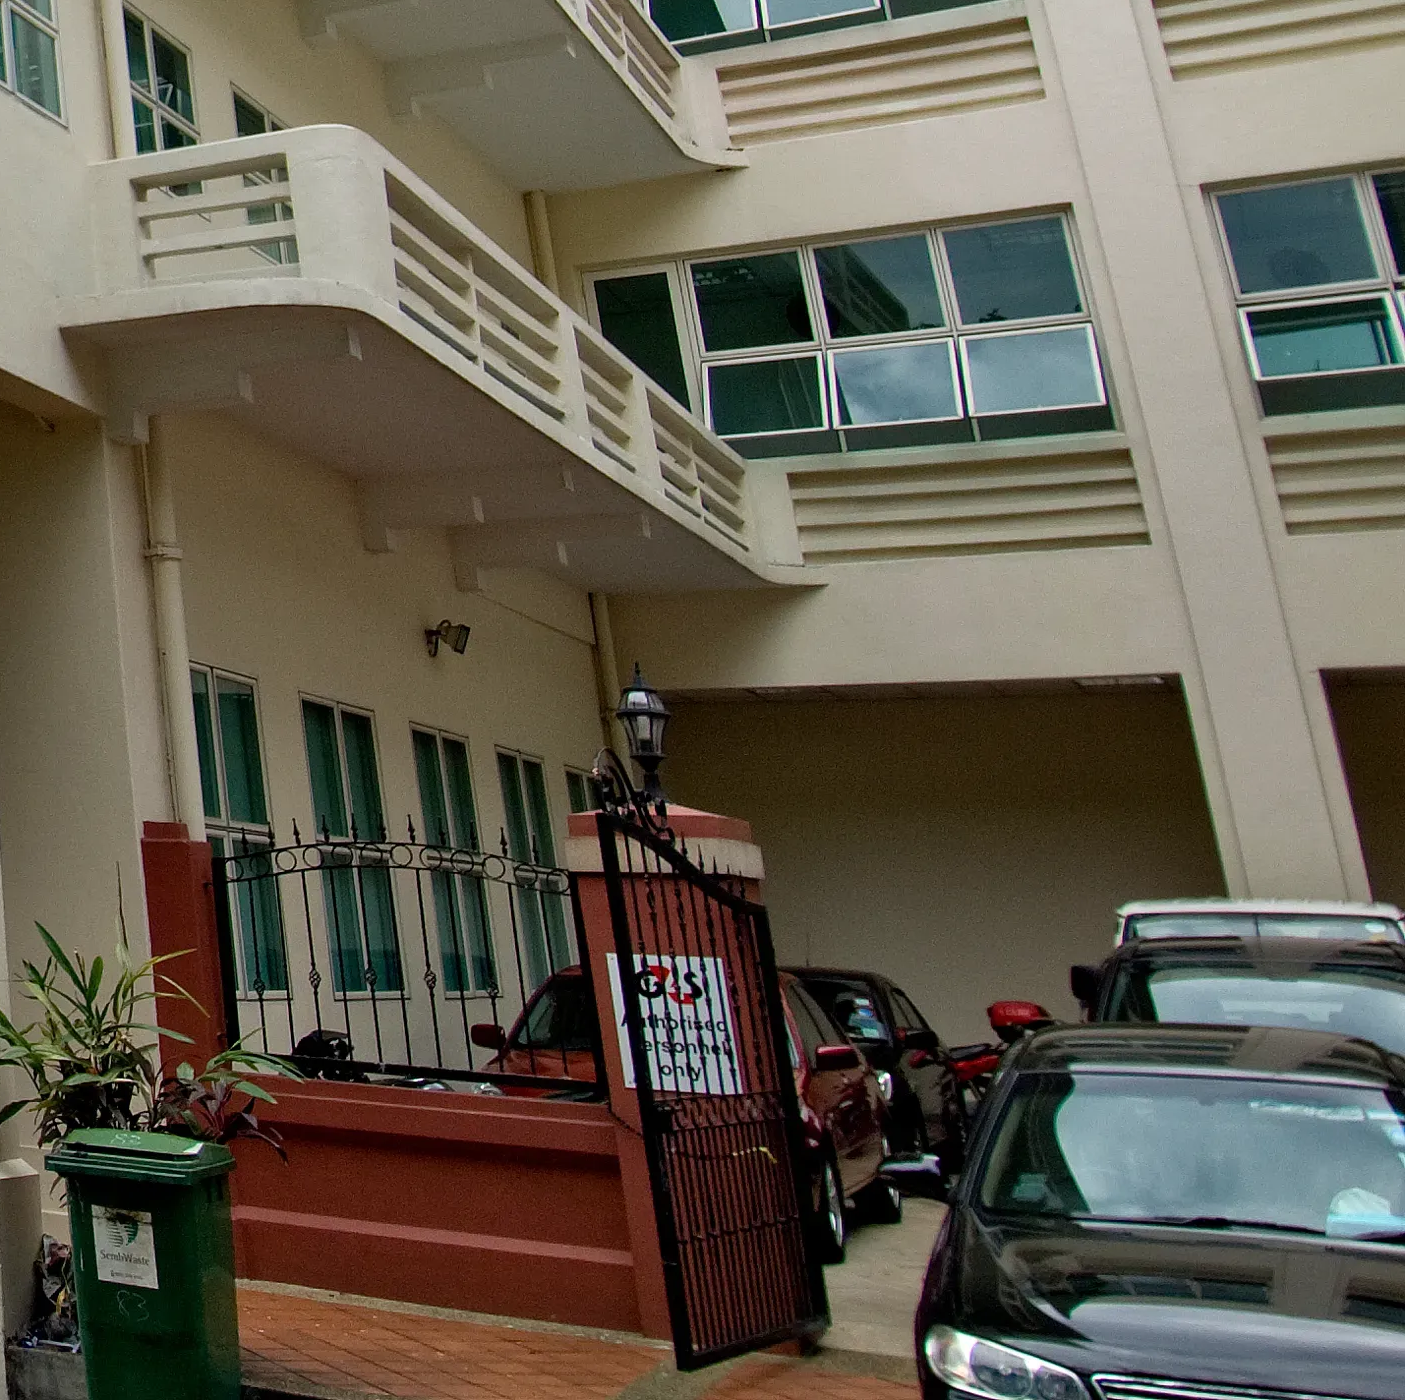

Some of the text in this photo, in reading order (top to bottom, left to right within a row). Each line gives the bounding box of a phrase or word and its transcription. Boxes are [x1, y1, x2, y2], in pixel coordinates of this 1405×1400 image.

[621, 1012, 728, 1032] thorised
[638, 1038, 731, 1055] ersonnel
[660, 1063, 701, 1082] ony
[100, 1249, 150, 1267] SembWaste
